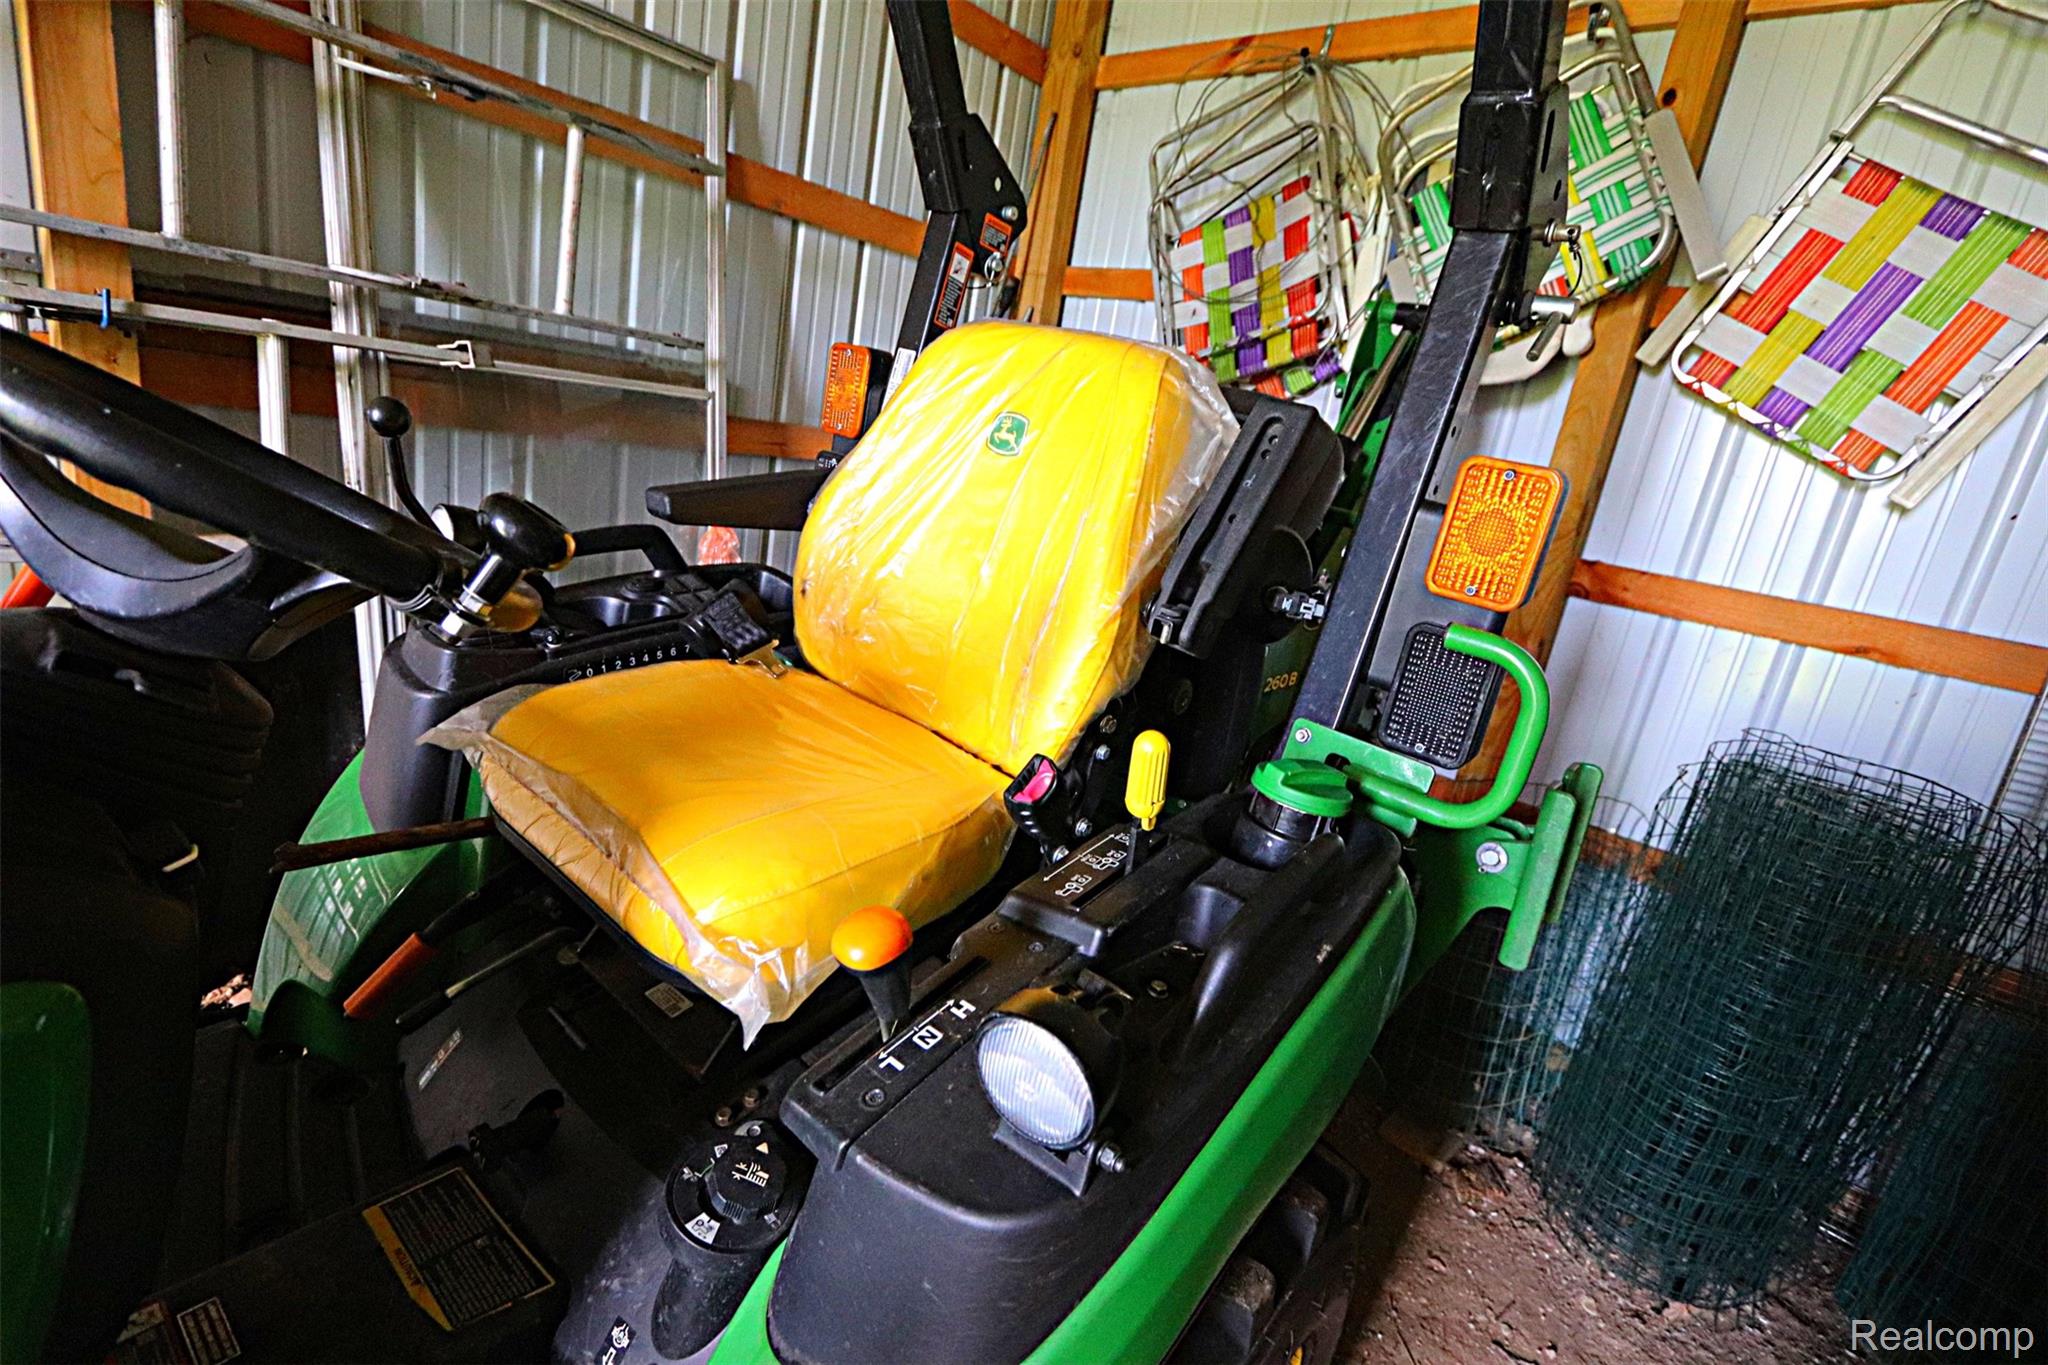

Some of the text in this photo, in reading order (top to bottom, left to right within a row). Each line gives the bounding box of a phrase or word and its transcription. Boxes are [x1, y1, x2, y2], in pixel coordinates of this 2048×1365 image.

[586, 668, 593, 678] 0
[615, 660, 622, 669] 2
[629, 656, 636, 666] 3
[642, 653, 649, 662] 4
[656, 650, 663, 659] 5
[670, 647, 677, 656] 6
[684, 644, 691, 653] 7
[950, 1000, 977, 1020] H
[878, 1055, 905, 1072] L
